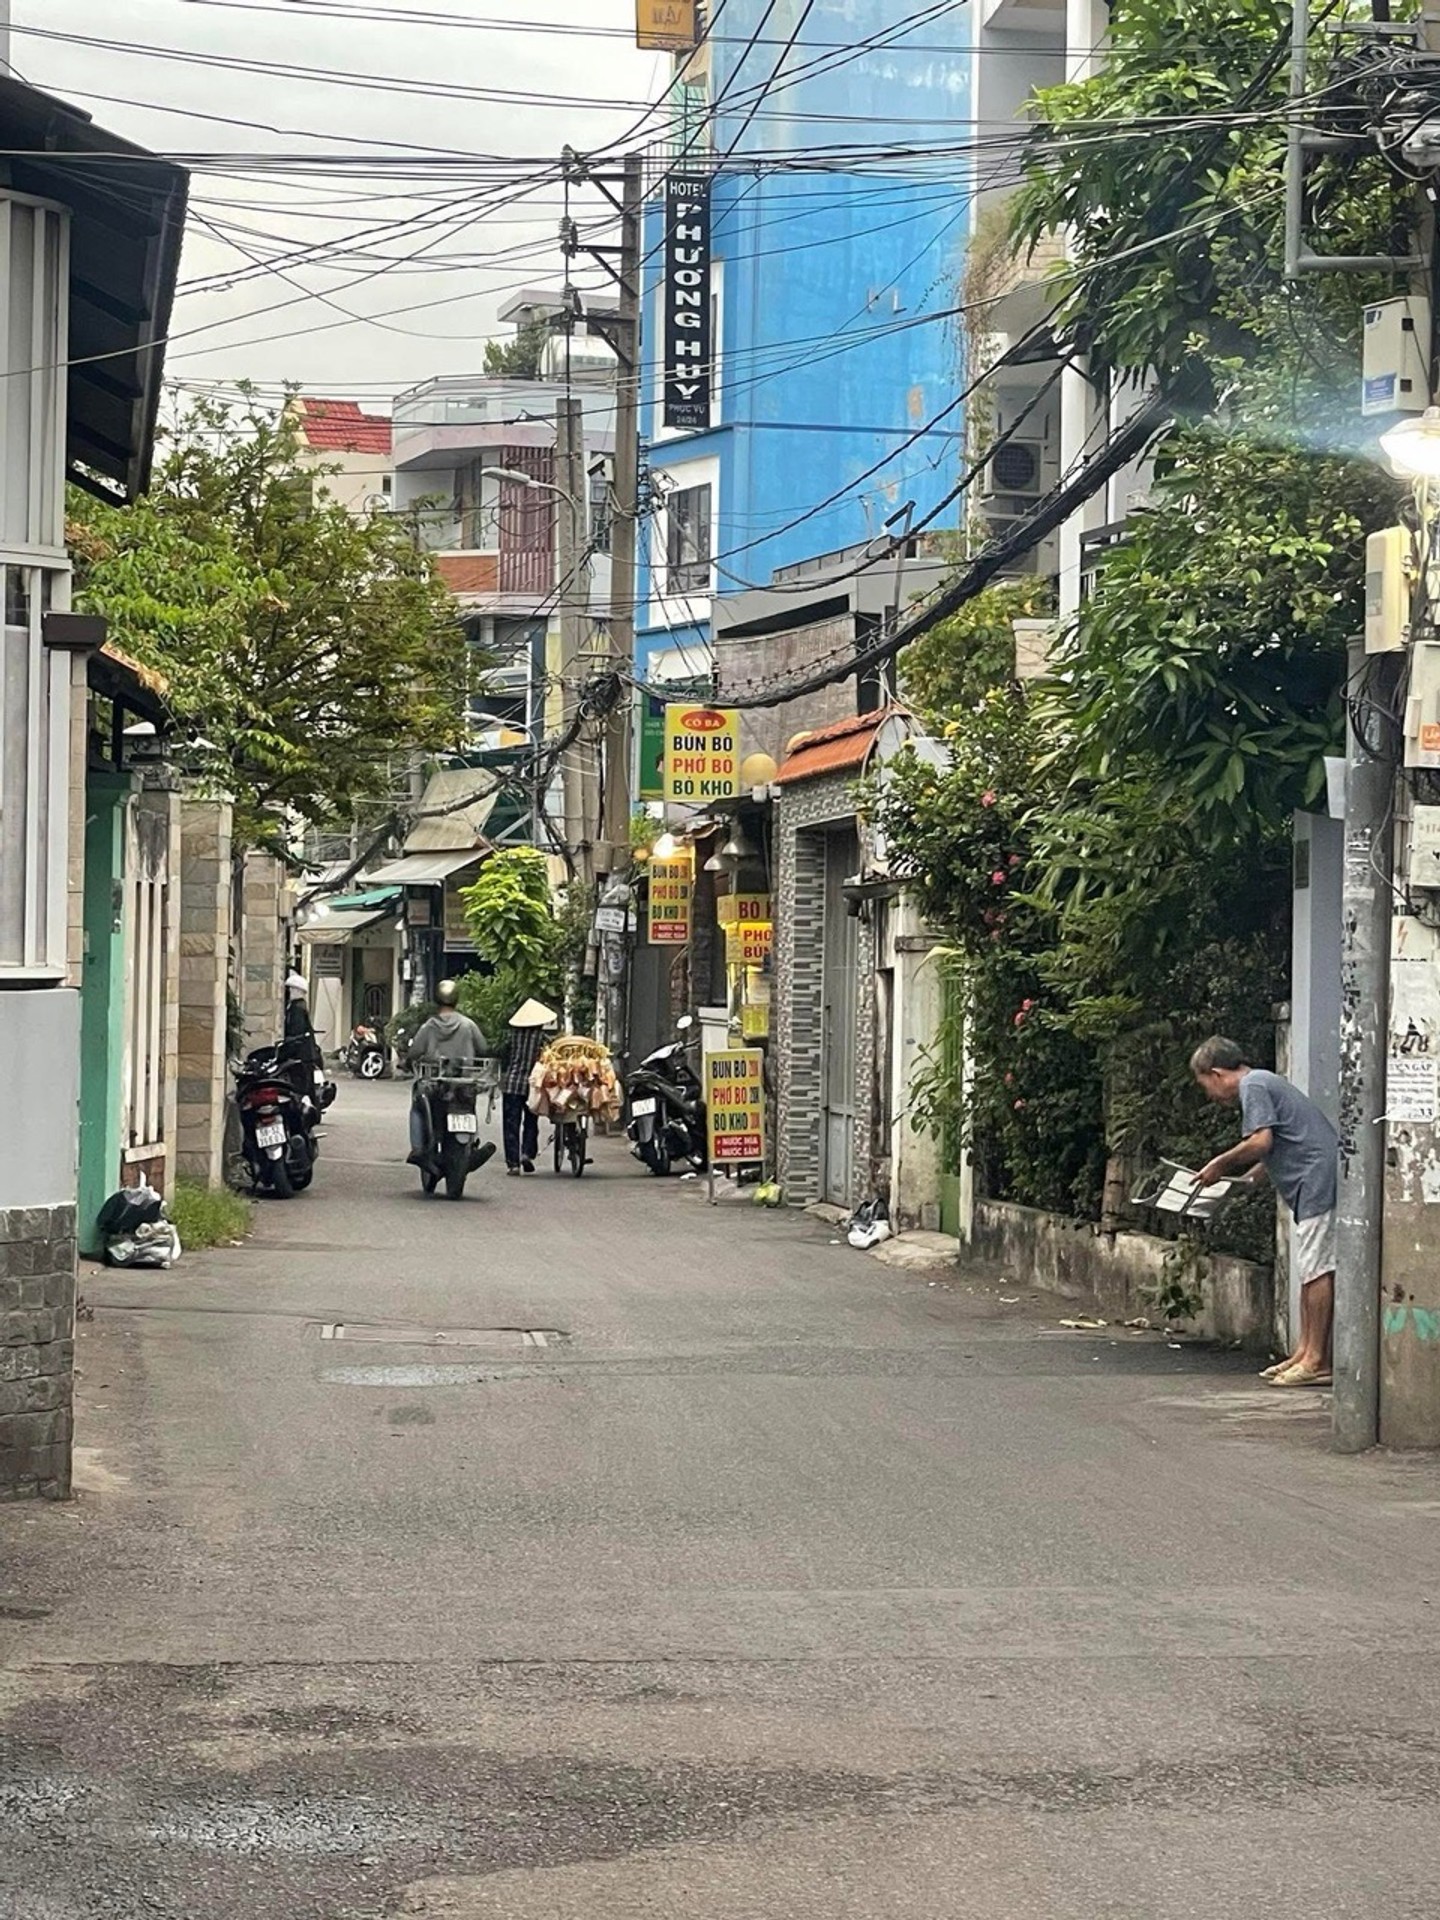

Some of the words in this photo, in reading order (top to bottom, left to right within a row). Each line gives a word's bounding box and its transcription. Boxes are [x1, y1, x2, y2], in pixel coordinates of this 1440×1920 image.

[670, 182, 707, 197] HOTEL
[675, 340, 701, 400] HUY
[673, 732, 706, 751] BÚN
[712, 732, 733, 751] BÒ
[673, 754, 706, 774] PHỞ
[712, 755, 733, 774] BÒ
[673, 776, 694, 795] BÒ
[700, 780, 733, 796] KHO
[739, 897, 760, 919] BÒ
[729, 1112, 748, 1130] KHO
